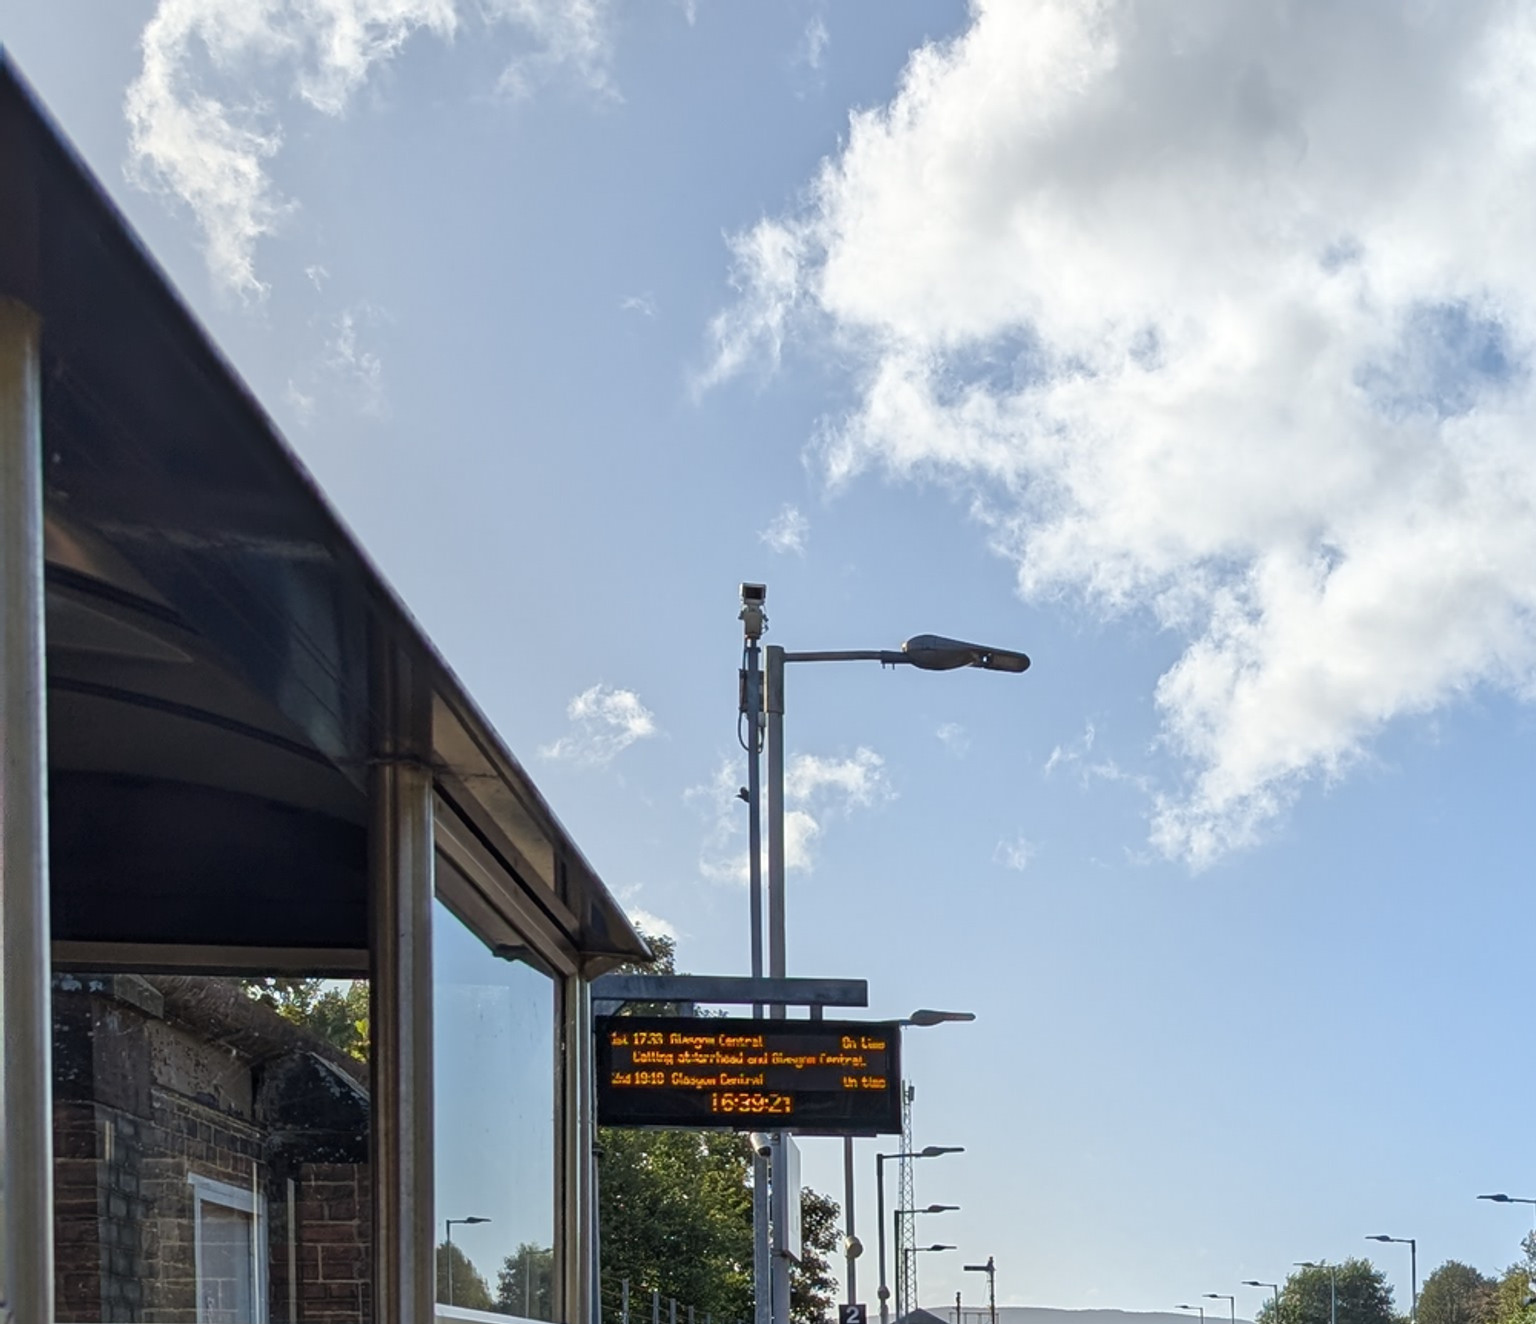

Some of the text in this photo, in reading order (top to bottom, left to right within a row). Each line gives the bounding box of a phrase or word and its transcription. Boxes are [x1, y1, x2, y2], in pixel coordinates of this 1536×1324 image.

[669, 1033, 715, 1049] Glasgow
[718, 1034, 763, 1047] Central
[842, 1036, 886, 1050] On time
[632, 1050, 674, 1065] Calling
[747, 1051, 767, 1064] and
[772, 1052, 817, 1069] Glasgow
[671, 1072, 717, 1089] Glasgow
[719, 1073, 764, 1085] Central
[712, 1092, 791, 1112] 16:39:21
[847, 1306, 859, 1324] 2
